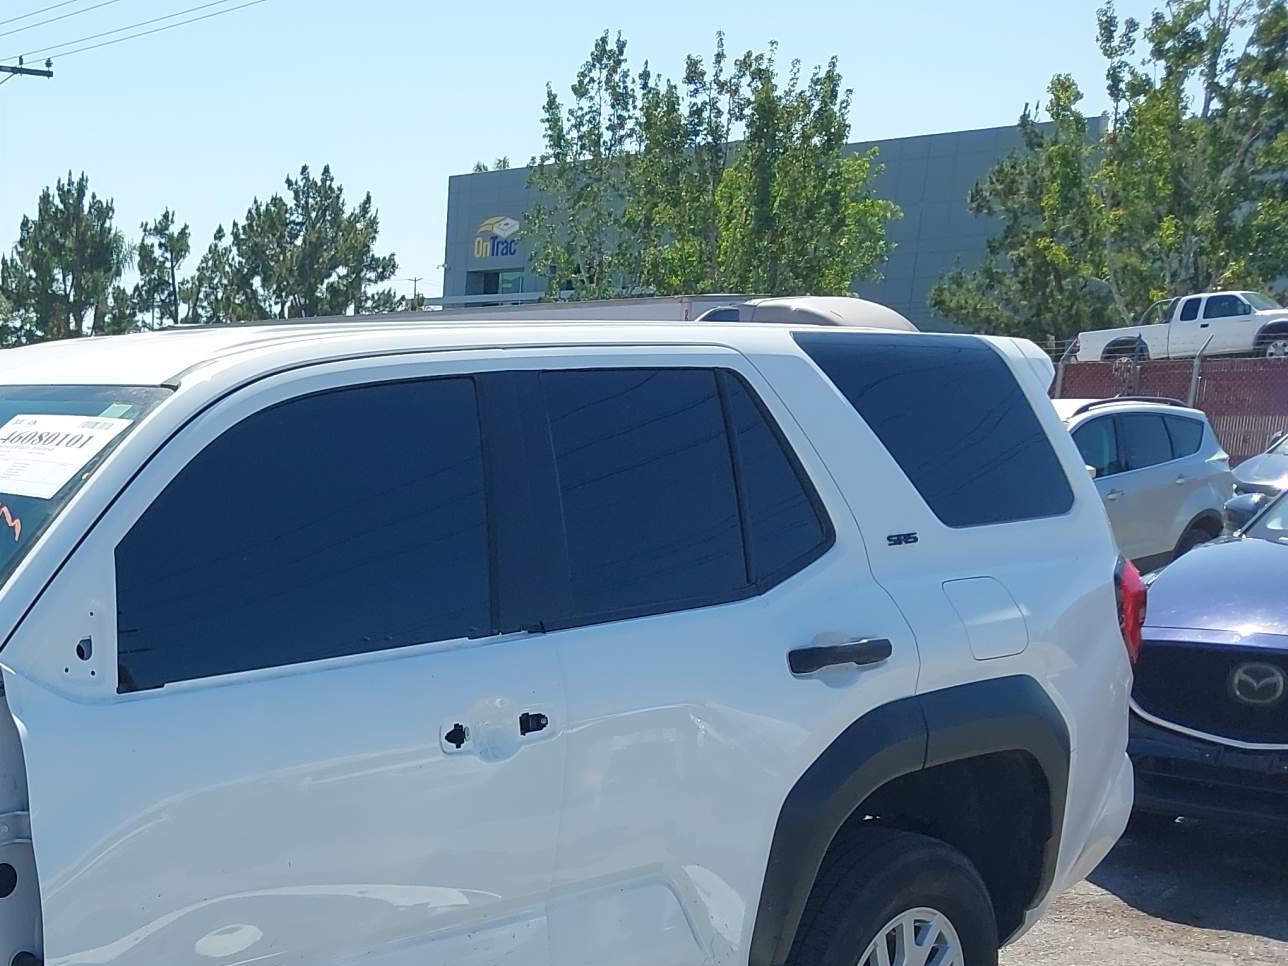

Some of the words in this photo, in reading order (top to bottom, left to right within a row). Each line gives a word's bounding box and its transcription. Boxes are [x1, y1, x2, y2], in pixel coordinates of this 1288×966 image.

[475, 235, 517, 258] OnTrac
[0, 431, 94, 449] 46080101
[886, 531, 919, 546] SR5
